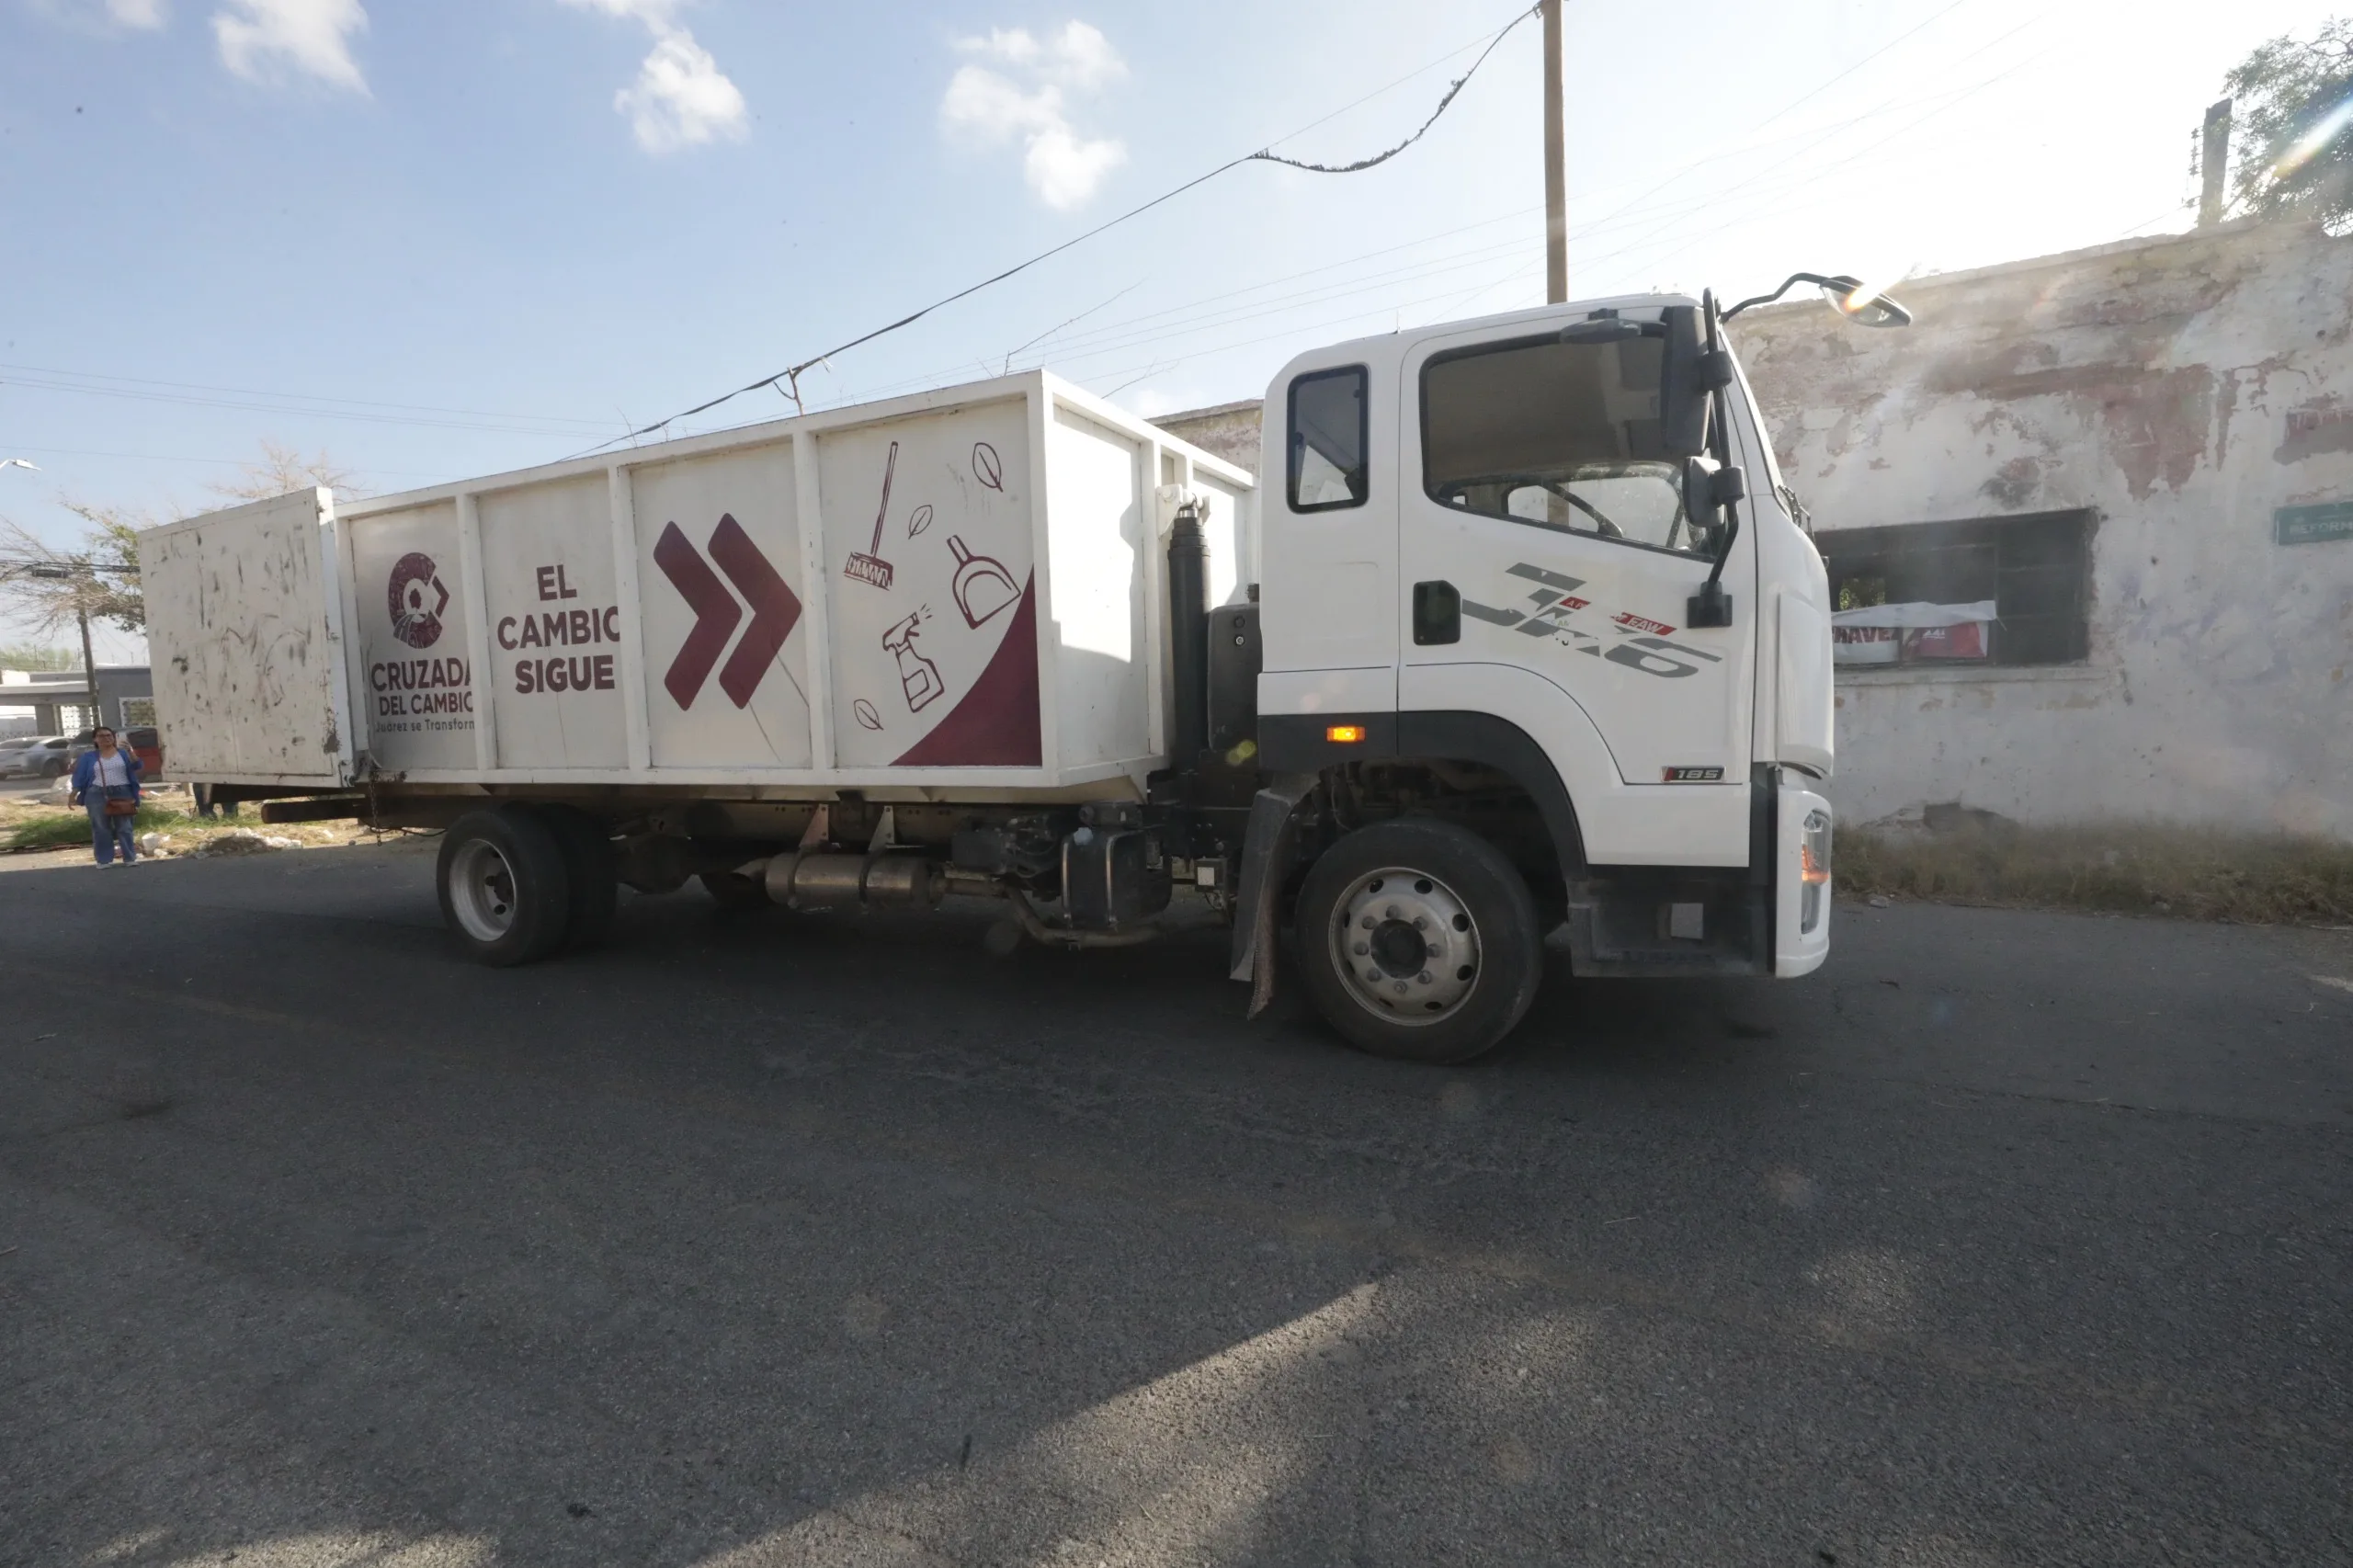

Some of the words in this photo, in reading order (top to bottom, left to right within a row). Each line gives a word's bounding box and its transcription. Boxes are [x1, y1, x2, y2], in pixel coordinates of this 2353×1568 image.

[537, 564, 577, 601] EL
[515, 654, 615, 694] SIGUE
[379, 695, 407, 716] DEL
[411, 722, 422, 732] se
[1677, 769, 1719, 779] 185
